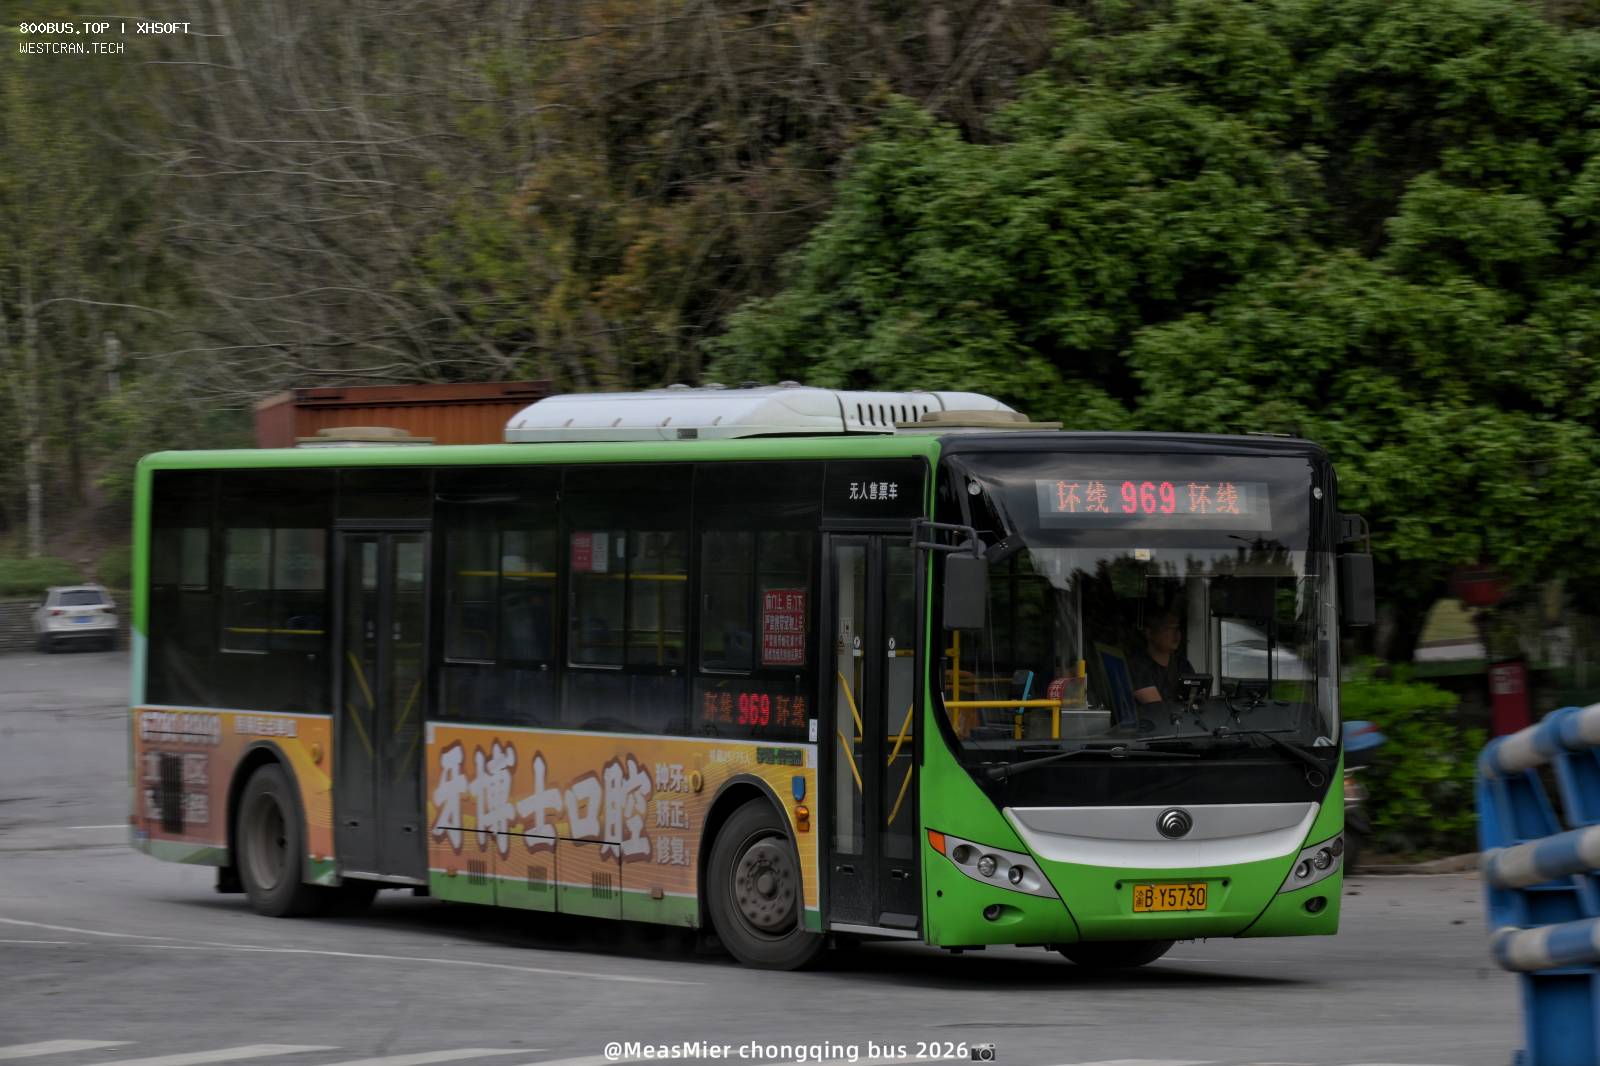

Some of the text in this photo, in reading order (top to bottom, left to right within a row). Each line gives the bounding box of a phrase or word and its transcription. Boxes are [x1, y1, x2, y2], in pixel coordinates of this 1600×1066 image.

[849, 481, 898, 500] 无人售票车
[1056, 480, 1241, 515] 环线 969 环线
[737, 692, 770, 726] 969
[433, 740, 652, 859] 牙博士口腔
